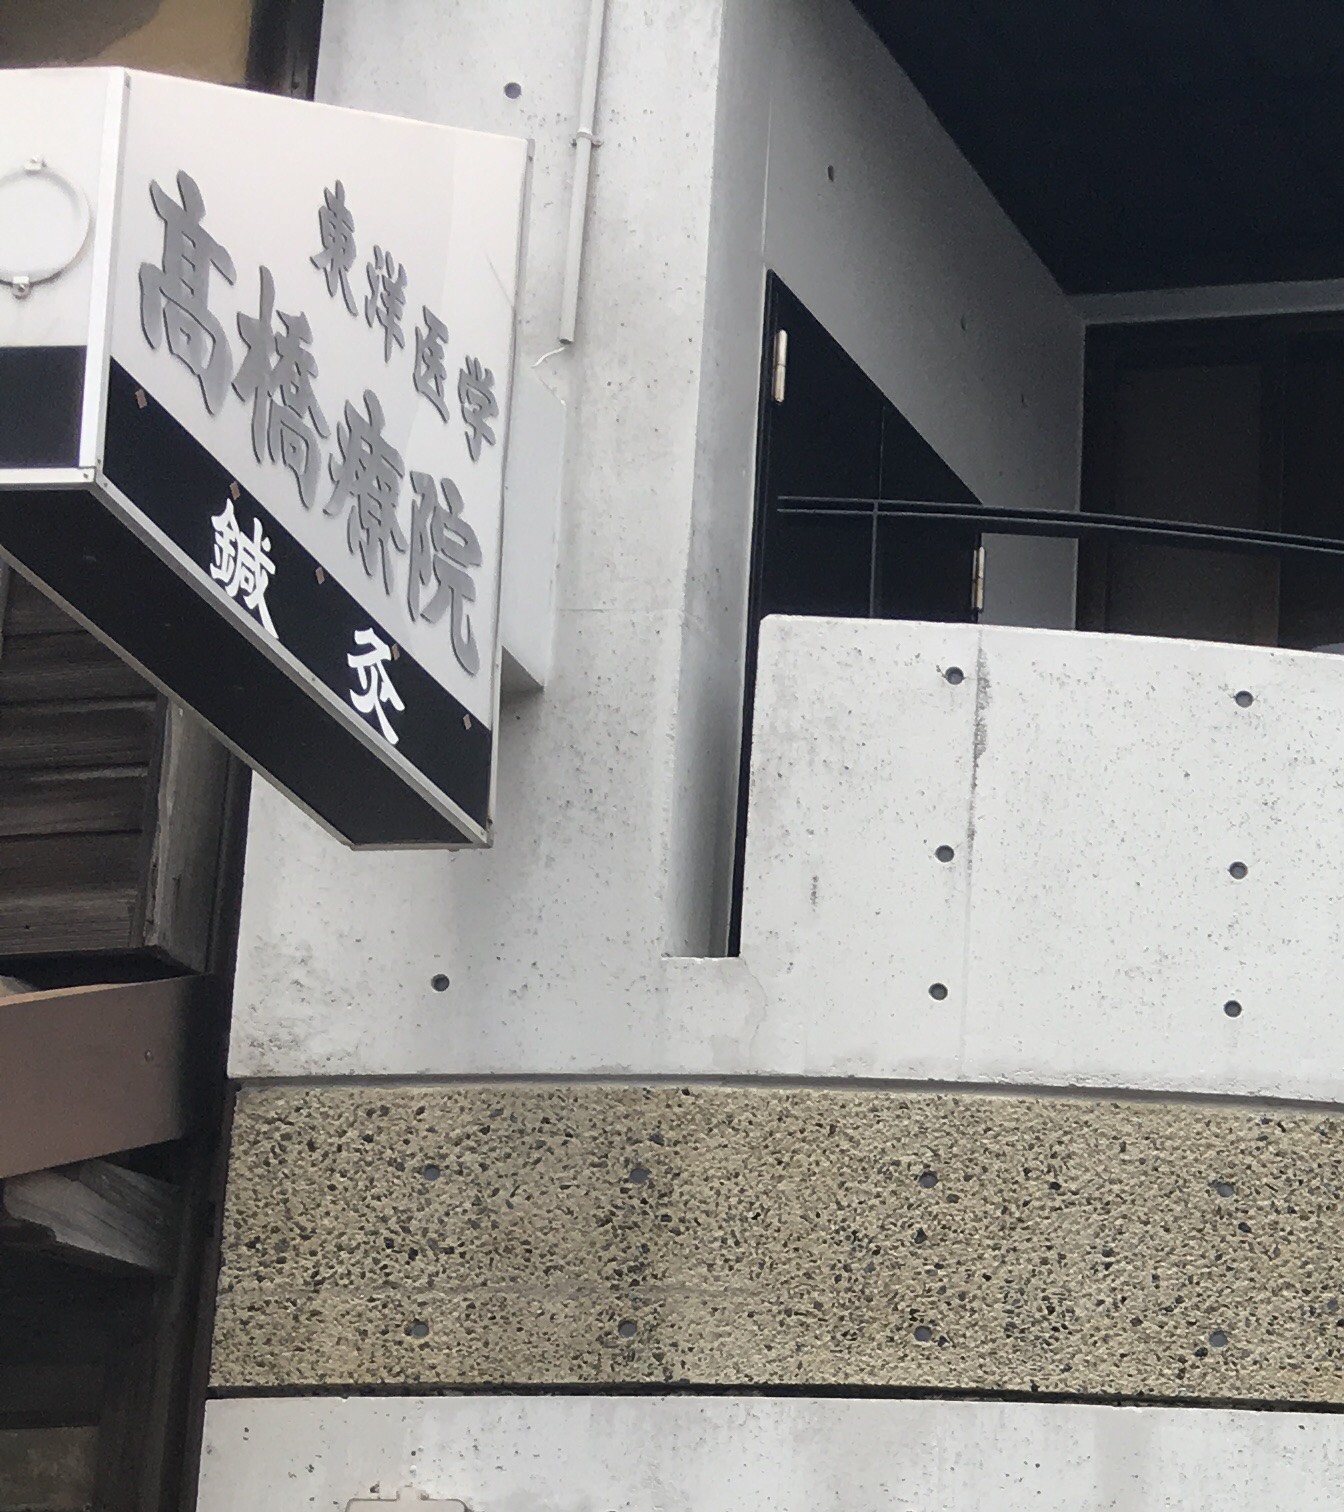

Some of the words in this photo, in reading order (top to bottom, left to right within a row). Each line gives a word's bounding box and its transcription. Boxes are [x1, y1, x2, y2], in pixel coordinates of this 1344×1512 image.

[311, 180, 500, 462] 東洋医学
[210, 498, 405, 745] 鍼灸
